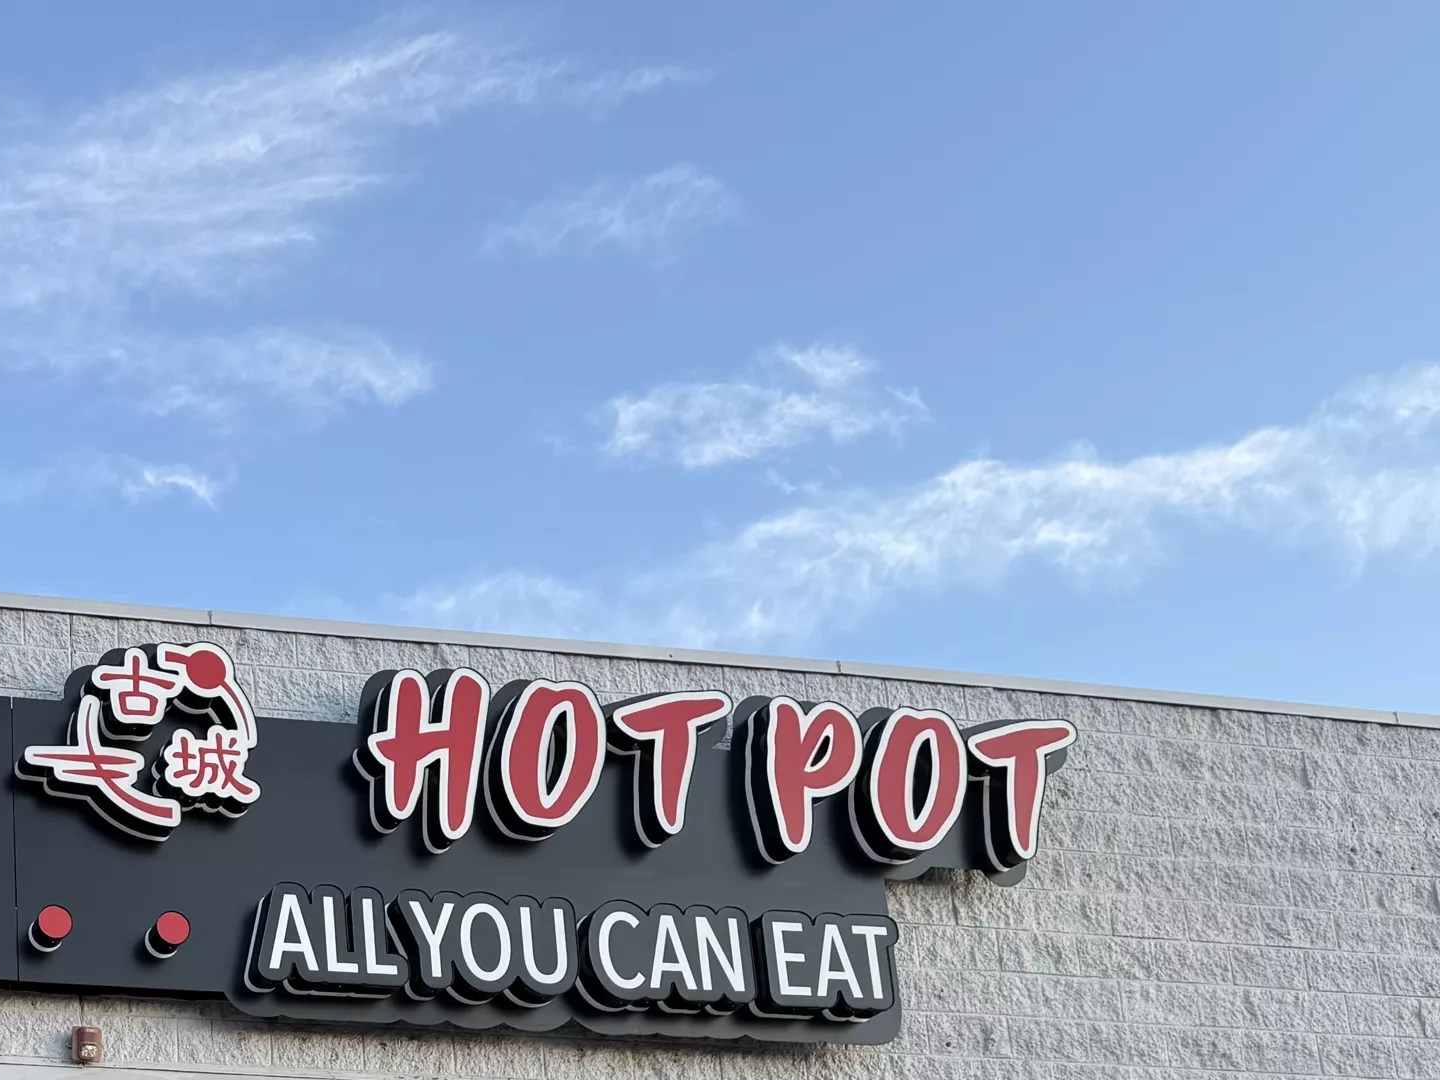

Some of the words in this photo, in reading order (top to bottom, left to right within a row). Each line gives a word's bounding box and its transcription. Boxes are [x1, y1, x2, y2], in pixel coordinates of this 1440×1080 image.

[367, 667, 733, 842] HOT
[763, 694, 1077, 862] POT
[268, 893, 399, 977] ALL
[407, 900, 564, 985] YOU
[597, 910, 746, 993] CAN
[770, 920, 890, 1000] EAT
